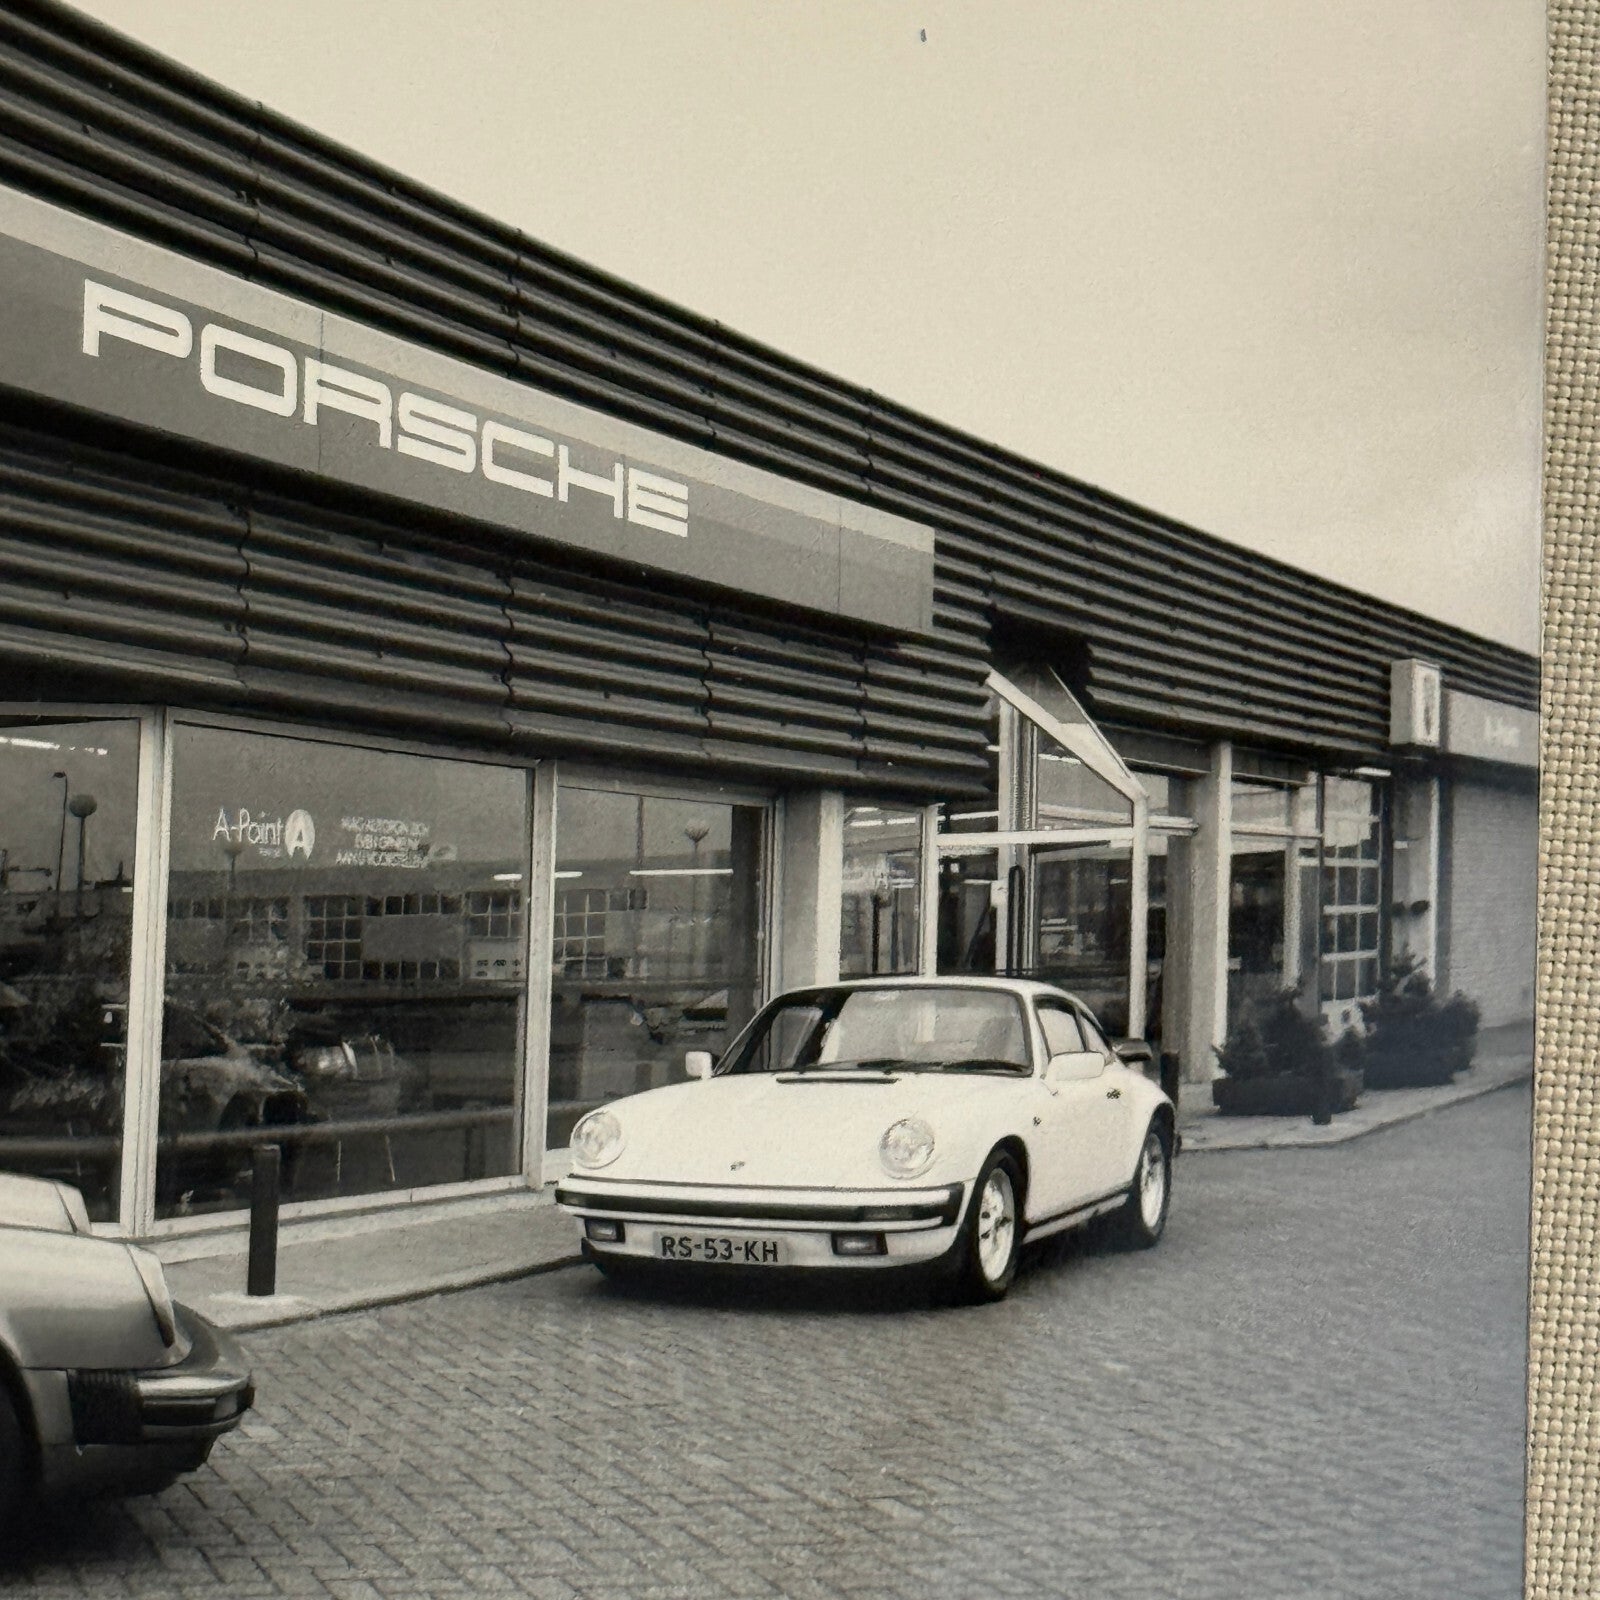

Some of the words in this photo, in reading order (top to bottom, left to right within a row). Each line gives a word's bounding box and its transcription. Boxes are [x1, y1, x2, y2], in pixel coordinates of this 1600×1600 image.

[81, 278, 690, 538] PORSCHE
[211, 806, 284, 846] A-Point
[660, 1235, 779, 1263] RS-53-KH
